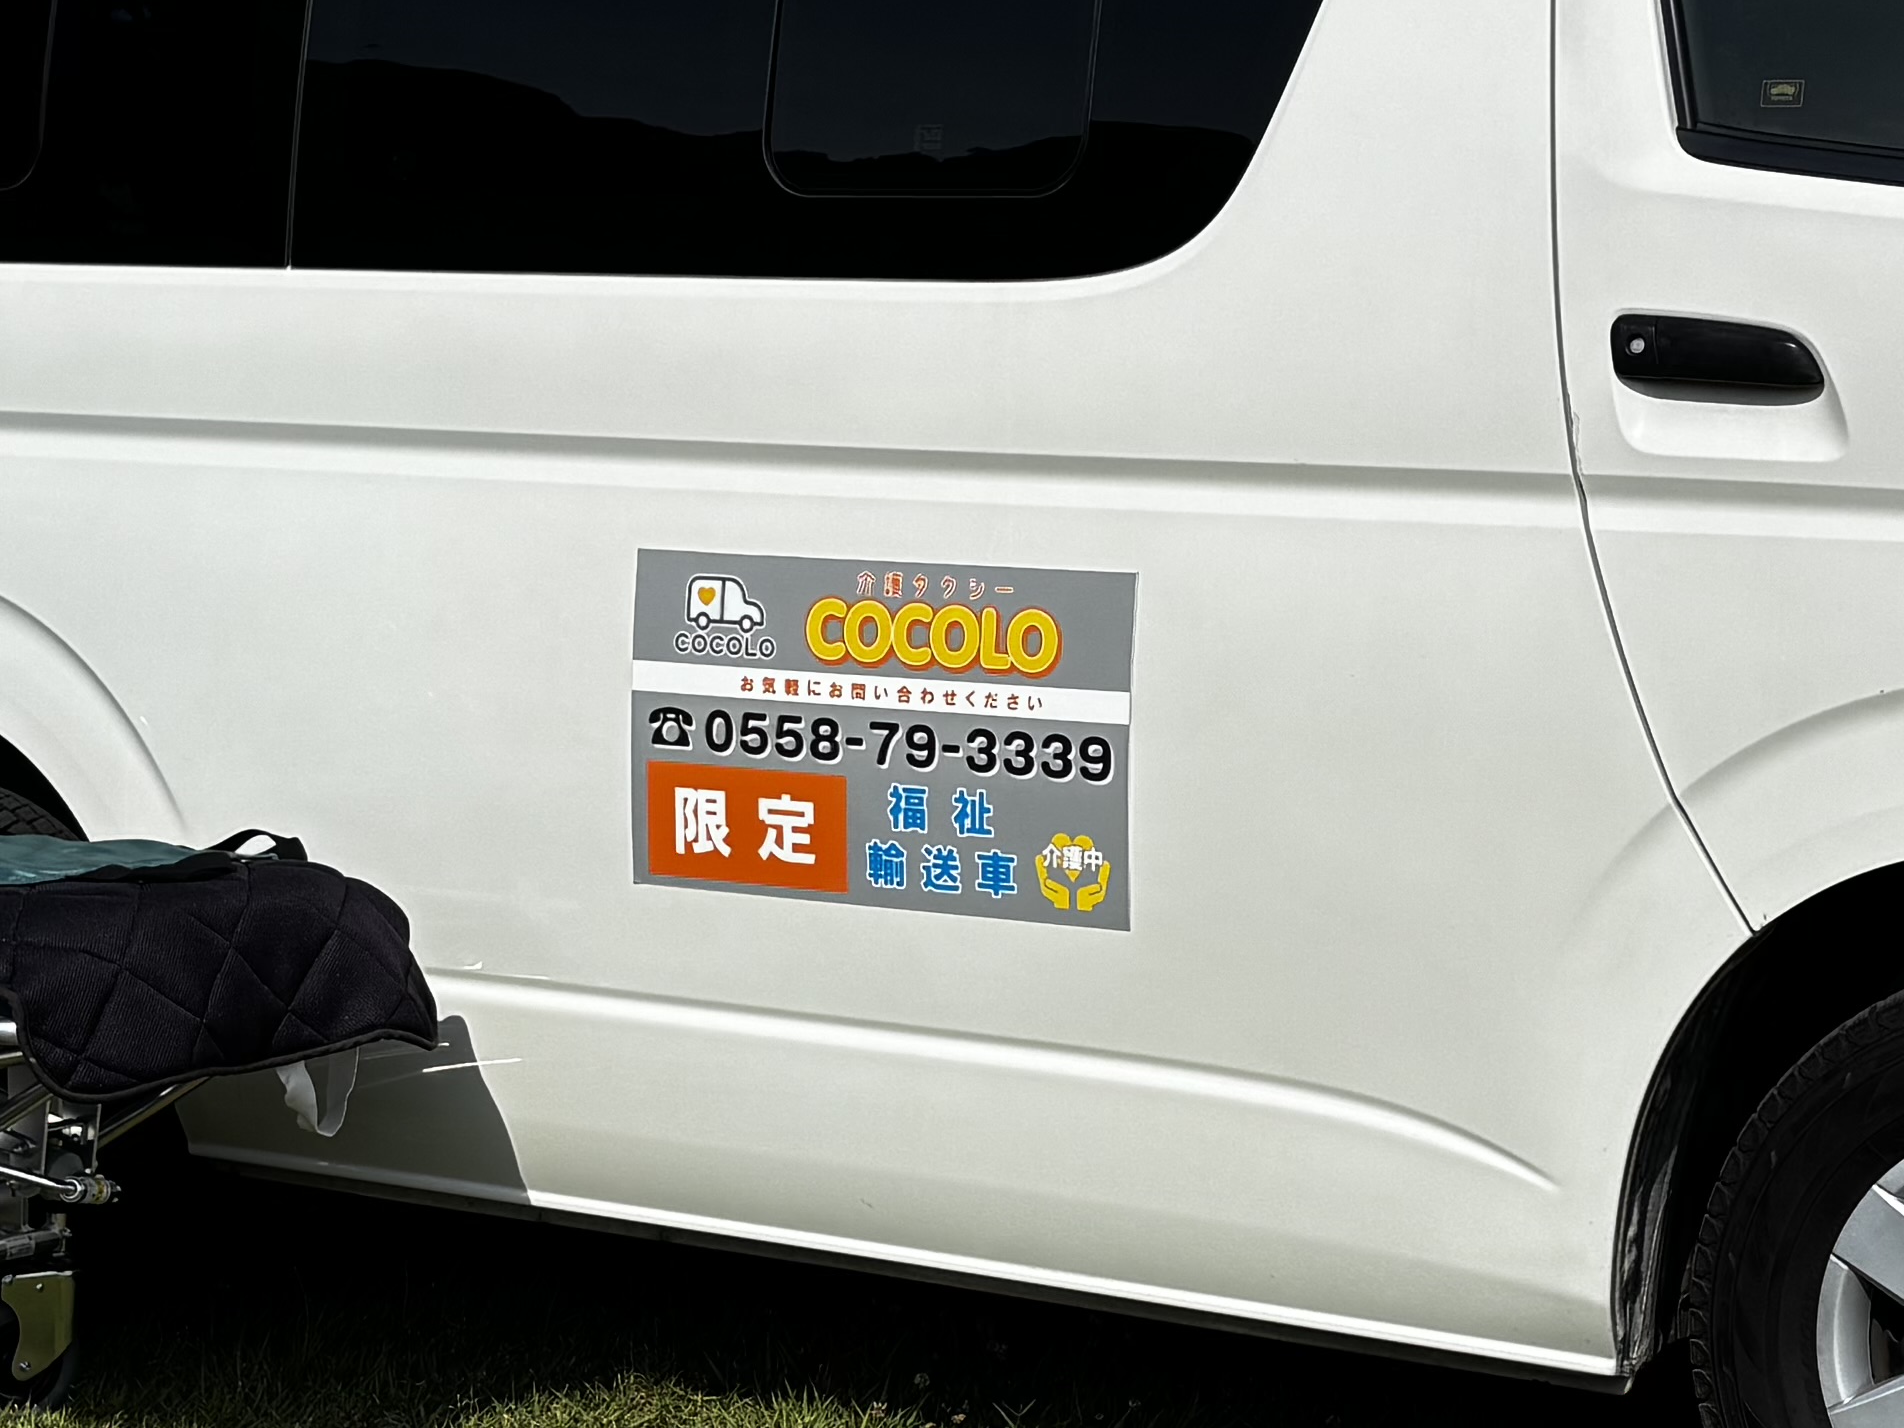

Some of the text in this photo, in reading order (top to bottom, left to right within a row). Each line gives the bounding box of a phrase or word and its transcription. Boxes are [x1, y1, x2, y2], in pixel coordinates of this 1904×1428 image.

[856, 570, 1014, 600] 介護タクシー
[674, 630, 777, 659] COCOLO
[804, 595, 1063, 679] COCOLO
[740, 675, 1043, 711] お気軽にお問い合わせください
[704, 709, 1114, 785] 0558-79-3339
[674, 786, 817, 865] 限定
[887, 782, 994, 838] 福祉
[865, 838, 1018, 899] 輸送車
[1042, 844, 1103, 872] 介護中
